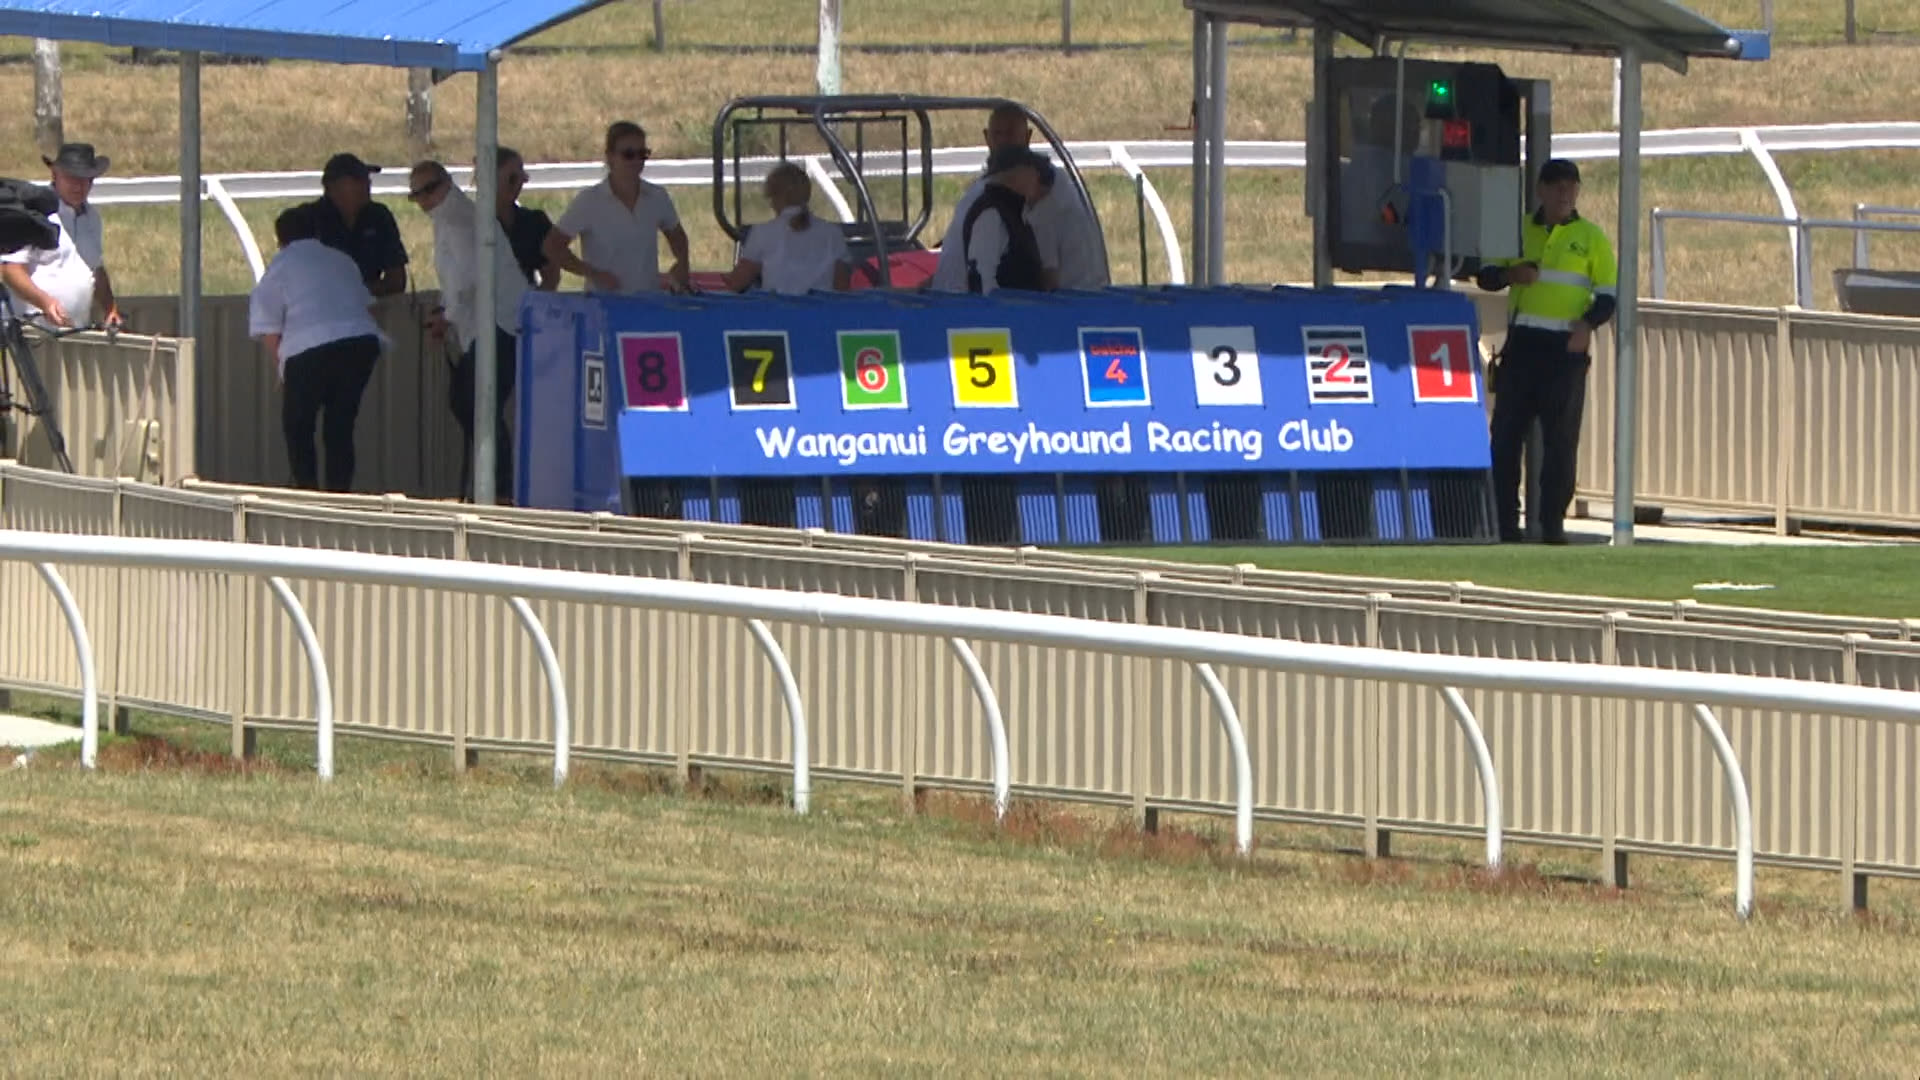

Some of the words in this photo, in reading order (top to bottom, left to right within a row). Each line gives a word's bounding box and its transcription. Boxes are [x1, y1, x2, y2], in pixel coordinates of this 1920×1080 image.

[637, 350, 668, 393] 8
[743, 349, 775, 394] 7
[854, 346, 889, 393] 6
[968, 347, 997, 388] 5
[1105, 358, 1128, 384] 4
[1212, 345, 1241, 387] 3
[1321, 344, 1353, 384] 2
[1430, 343, 1453, 387] 1
[755, 425, 927, 466] Wanganui
[943, 421, 1132, 465] Greyhound
[1147, 420, 1263, 461] Racing
[1278, 418, 1354, 453] Club
